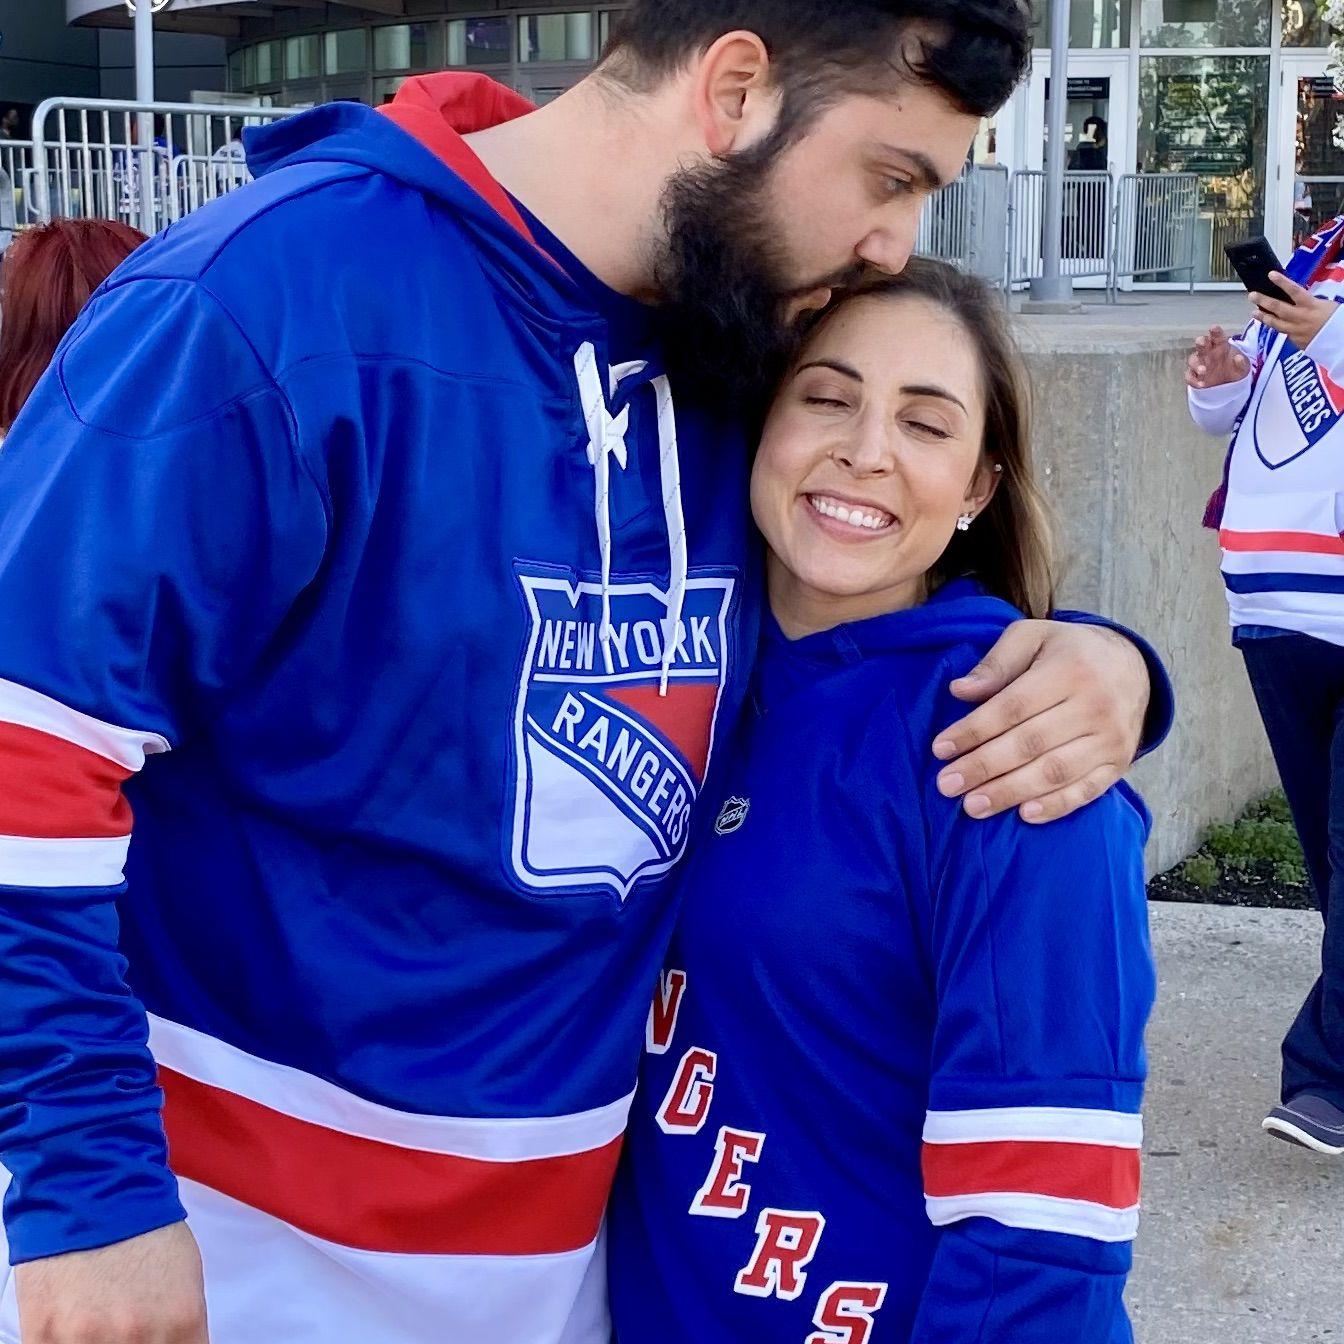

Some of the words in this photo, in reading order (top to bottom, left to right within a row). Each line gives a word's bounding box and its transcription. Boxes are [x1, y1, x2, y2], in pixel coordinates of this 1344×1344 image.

[1283, 349, 1332, 434] RANGERS
[537, 617, 596, 670] NEW
[607, 615, 718, 669] YORK
[551, 692, 691, 846] RANGERS
